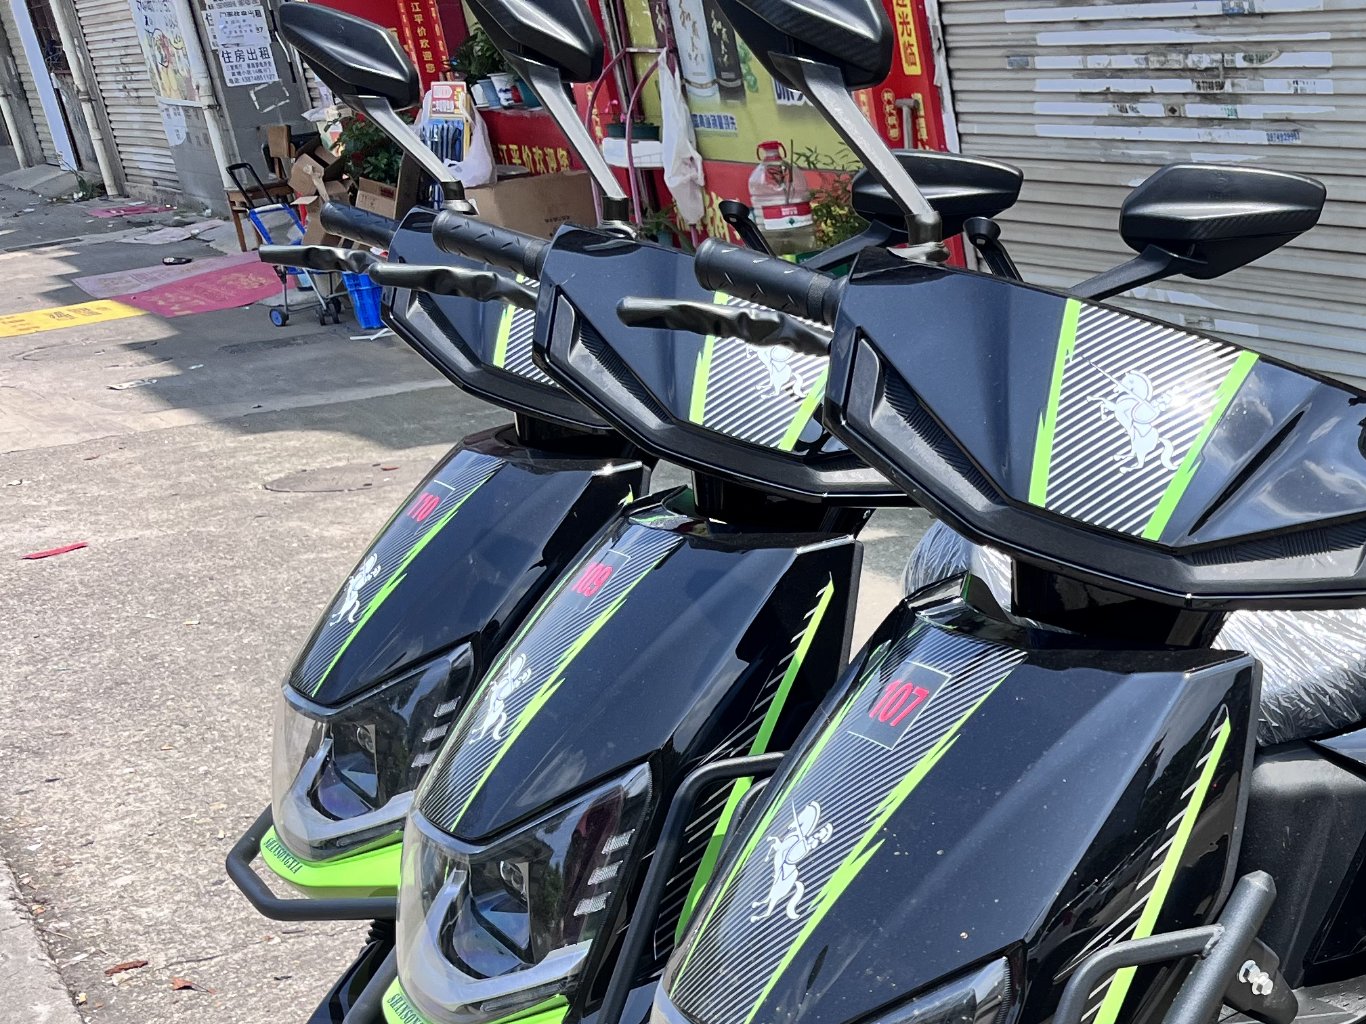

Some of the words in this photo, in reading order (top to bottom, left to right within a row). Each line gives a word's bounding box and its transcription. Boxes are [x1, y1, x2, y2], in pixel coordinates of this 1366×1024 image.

[221, 46, 271, 63] 住房出租
[571, 562, 614, 597] 109
[869, 678, 930, 727] 107
